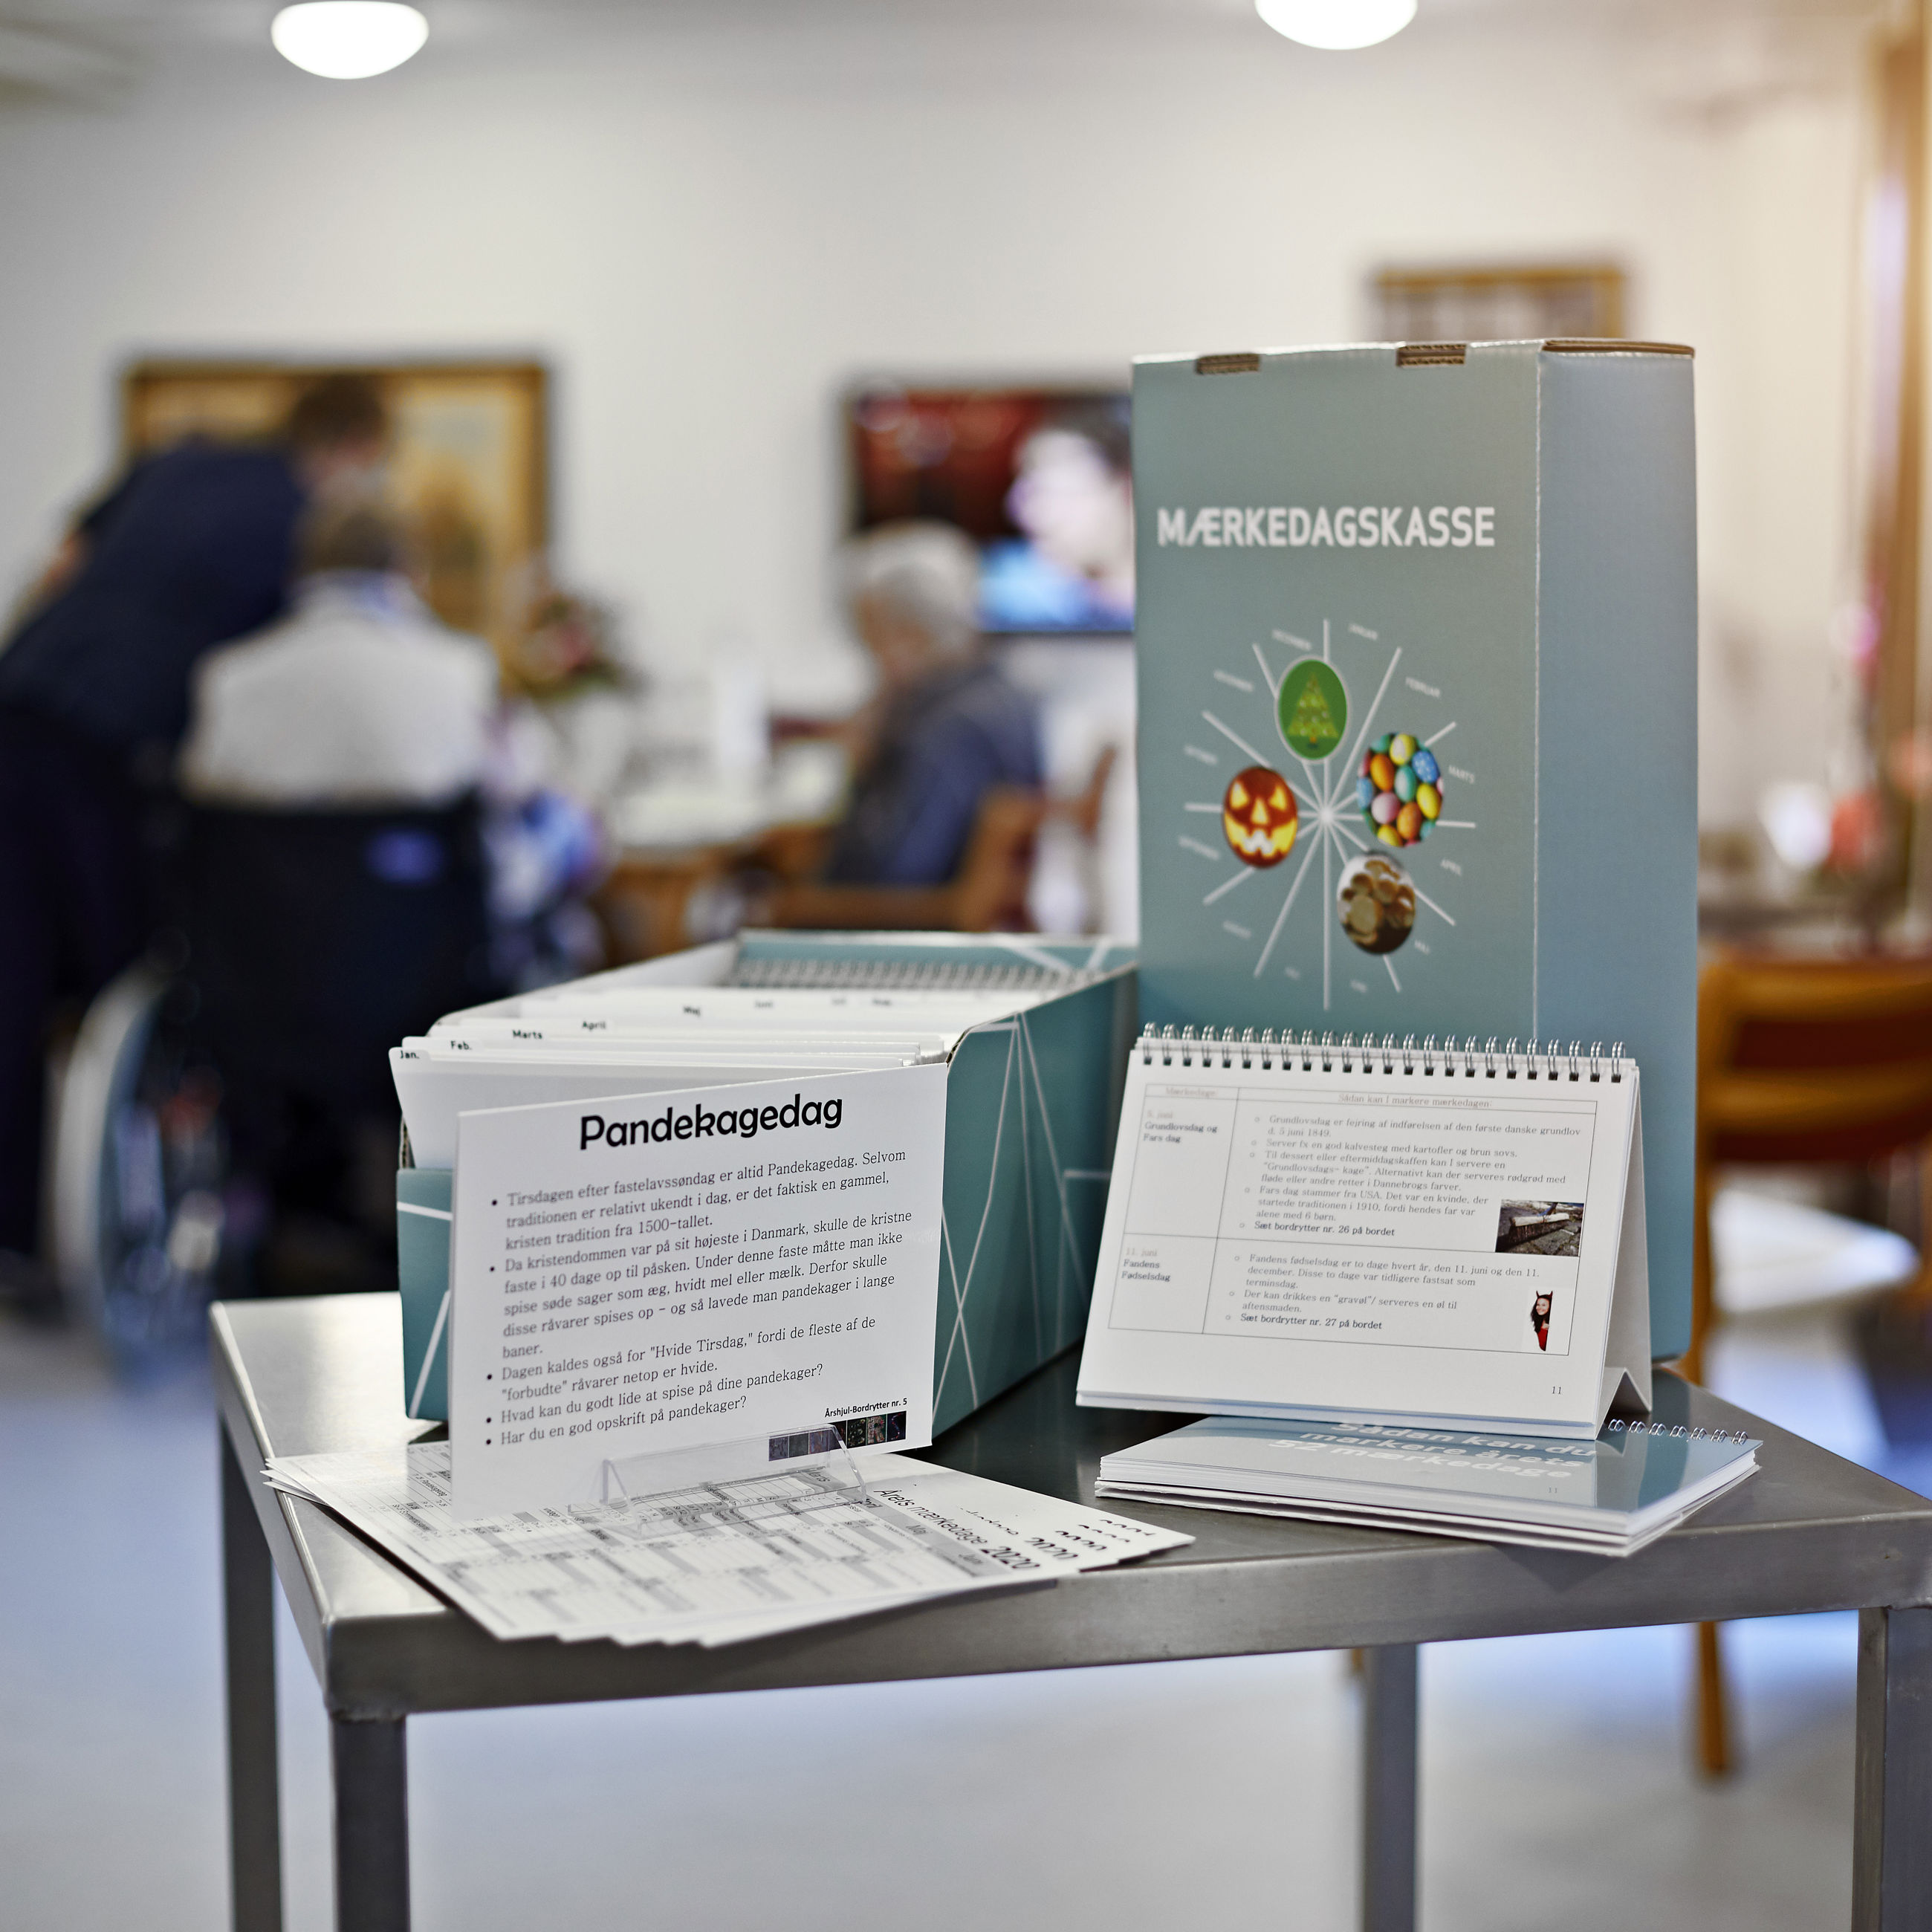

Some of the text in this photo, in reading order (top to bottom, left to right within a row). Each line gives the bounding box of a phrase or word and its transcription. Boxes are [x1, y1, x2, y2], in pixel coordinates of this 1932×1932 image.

[1158, 507, 1495, 547] MÆRKEDAGSKASSE
[512, 1029, 543, 1040] Marts
[582, 1020, 606, 1030] April
[399, 1050, 420, 1059] Jan.
[450, 1040, 473, 1051] Feb.
[580, 1094, 843, 1150] Pandekagedag
[509, 1151, 906, 1206] Tirsdagen efter fastelavssøndag er altid Pandekagedag. Selvom
[506, 1211, 577, 1228] traditionen
[580, 1209, 594, 1219] er
[599, 1202, 645, 1217] relativt
[650, 1194, 693, 1211] ukendt
[705, 1191, 731, 1205] dag,
[736, 1191, 747, 1201] er
[753, 1186, 773, 1199] det
[777, 1179, 817, 1196] faktisk
[821, 1180, 836, 1190] en
[839, 1171, 889, 1190] gammel,
[505, 1215, 713, 1250] kristen tradition fra 1500-tallet.
[505, 1258, 522, 1272] Da
[527, 1248, 626, 1269] kristendommen
[631, 1245, 649, 1255] var
[655, 1239, 670, 1255] på
[674, 1239, 690, 1251] sit
[694, 1233, 739, 1248] højeste
[751, 1222, 808, 1240] Danmark,
[813, 1218, 849, 1233] skulle
[852, 1215, 866, 1228] de
[870, 1212, 912, 1225] kristne
[1254, 1221, 1271, 1229] Sæt
[1274, 1222, 1320, 1231] bordrytter
[1351, 1226, 1362, 1235] på
[1364, 1227, 1395, 1236] bordet
[504, 1280, 537, 1294] faste
[549, 1273, 566, 1287] 40
[570, 1271, 601, 1285] dage
[605, 1270, 621, 1281] op
[626, 1264, 638, 1277] til
[642, 1260, 690, 1277] påsken.
[696, 1254, 730, 1268] Under
[736, 1251, 774, 1263] denne
[778, 1245, 808, 1258] faste
[811, 1239, 845, 1254] måtte
[849, 1237, 874, 1248] man
[877, 1231, 903, 1245] ikke
[1121, 1271, 1170, 1282] Fødselsdag
[1123, 1259, 1160, 1268] Fandens
[503, 1254, 887, 1317] spise søde sager som æg, hvidt mel eller mælk. Derfor skulle
[502, 1323, 537, 1337] disse
[541, 1317, 587, 1332] råvarer
[594, 1311, 634, 1326] spises
[638, 1308, 654, 1319] op
[670, 1303, 686, 1315] og
[690, 1297, 704, 1311] så
[707, 1293, 748, 1309] lavede
[752, 1291, 777, 1303] man
[781, 1282, 849, 1300] pandekager
[863, 1275, 895, 1288] lange
[1240, 1313, 1258, 1321] Sæt
[1260, 1314, 1307, 1325] bordrytter
[1324, 1317, 1337, 1326] 27
[1338, 1319, 1349, 1328] på
[1352, 1319, 1381, 1329] bordet
[502, 1316, 875, 1380] Dagen kaldes også for "Hvide Tirsdag," fordi de fleste af de
[502, 1344, 542, 1358] baner.
[501, 1363, 823, 1423] Hvad kan du godt lide at spise på dine pandekager?
[502, 1360, 717, 1401] "forbudte" råvarer netop er hvide.
[1552, 1386, 1561, 1394] 11
[500, 1395, 748, 1445] Har du en god opskrift på pandekager?
[824, 1403, 890, 1418] Årshjul-Bordrytter
[903, 1397, 907, 1405] 5
[1268, 1439, 1572, 1477] 52 mærkedage
[1300, 1432, 1585, 1468] markere årets
[1462, 1435, 1536, 1450] kan
[1545, 1445, 1597, 1456] du
[873, 1489, 915, 1506] Årets
[906, 1506, 988, 1544] mærkedage
[979, 1546, 1041, 1569] 2020
